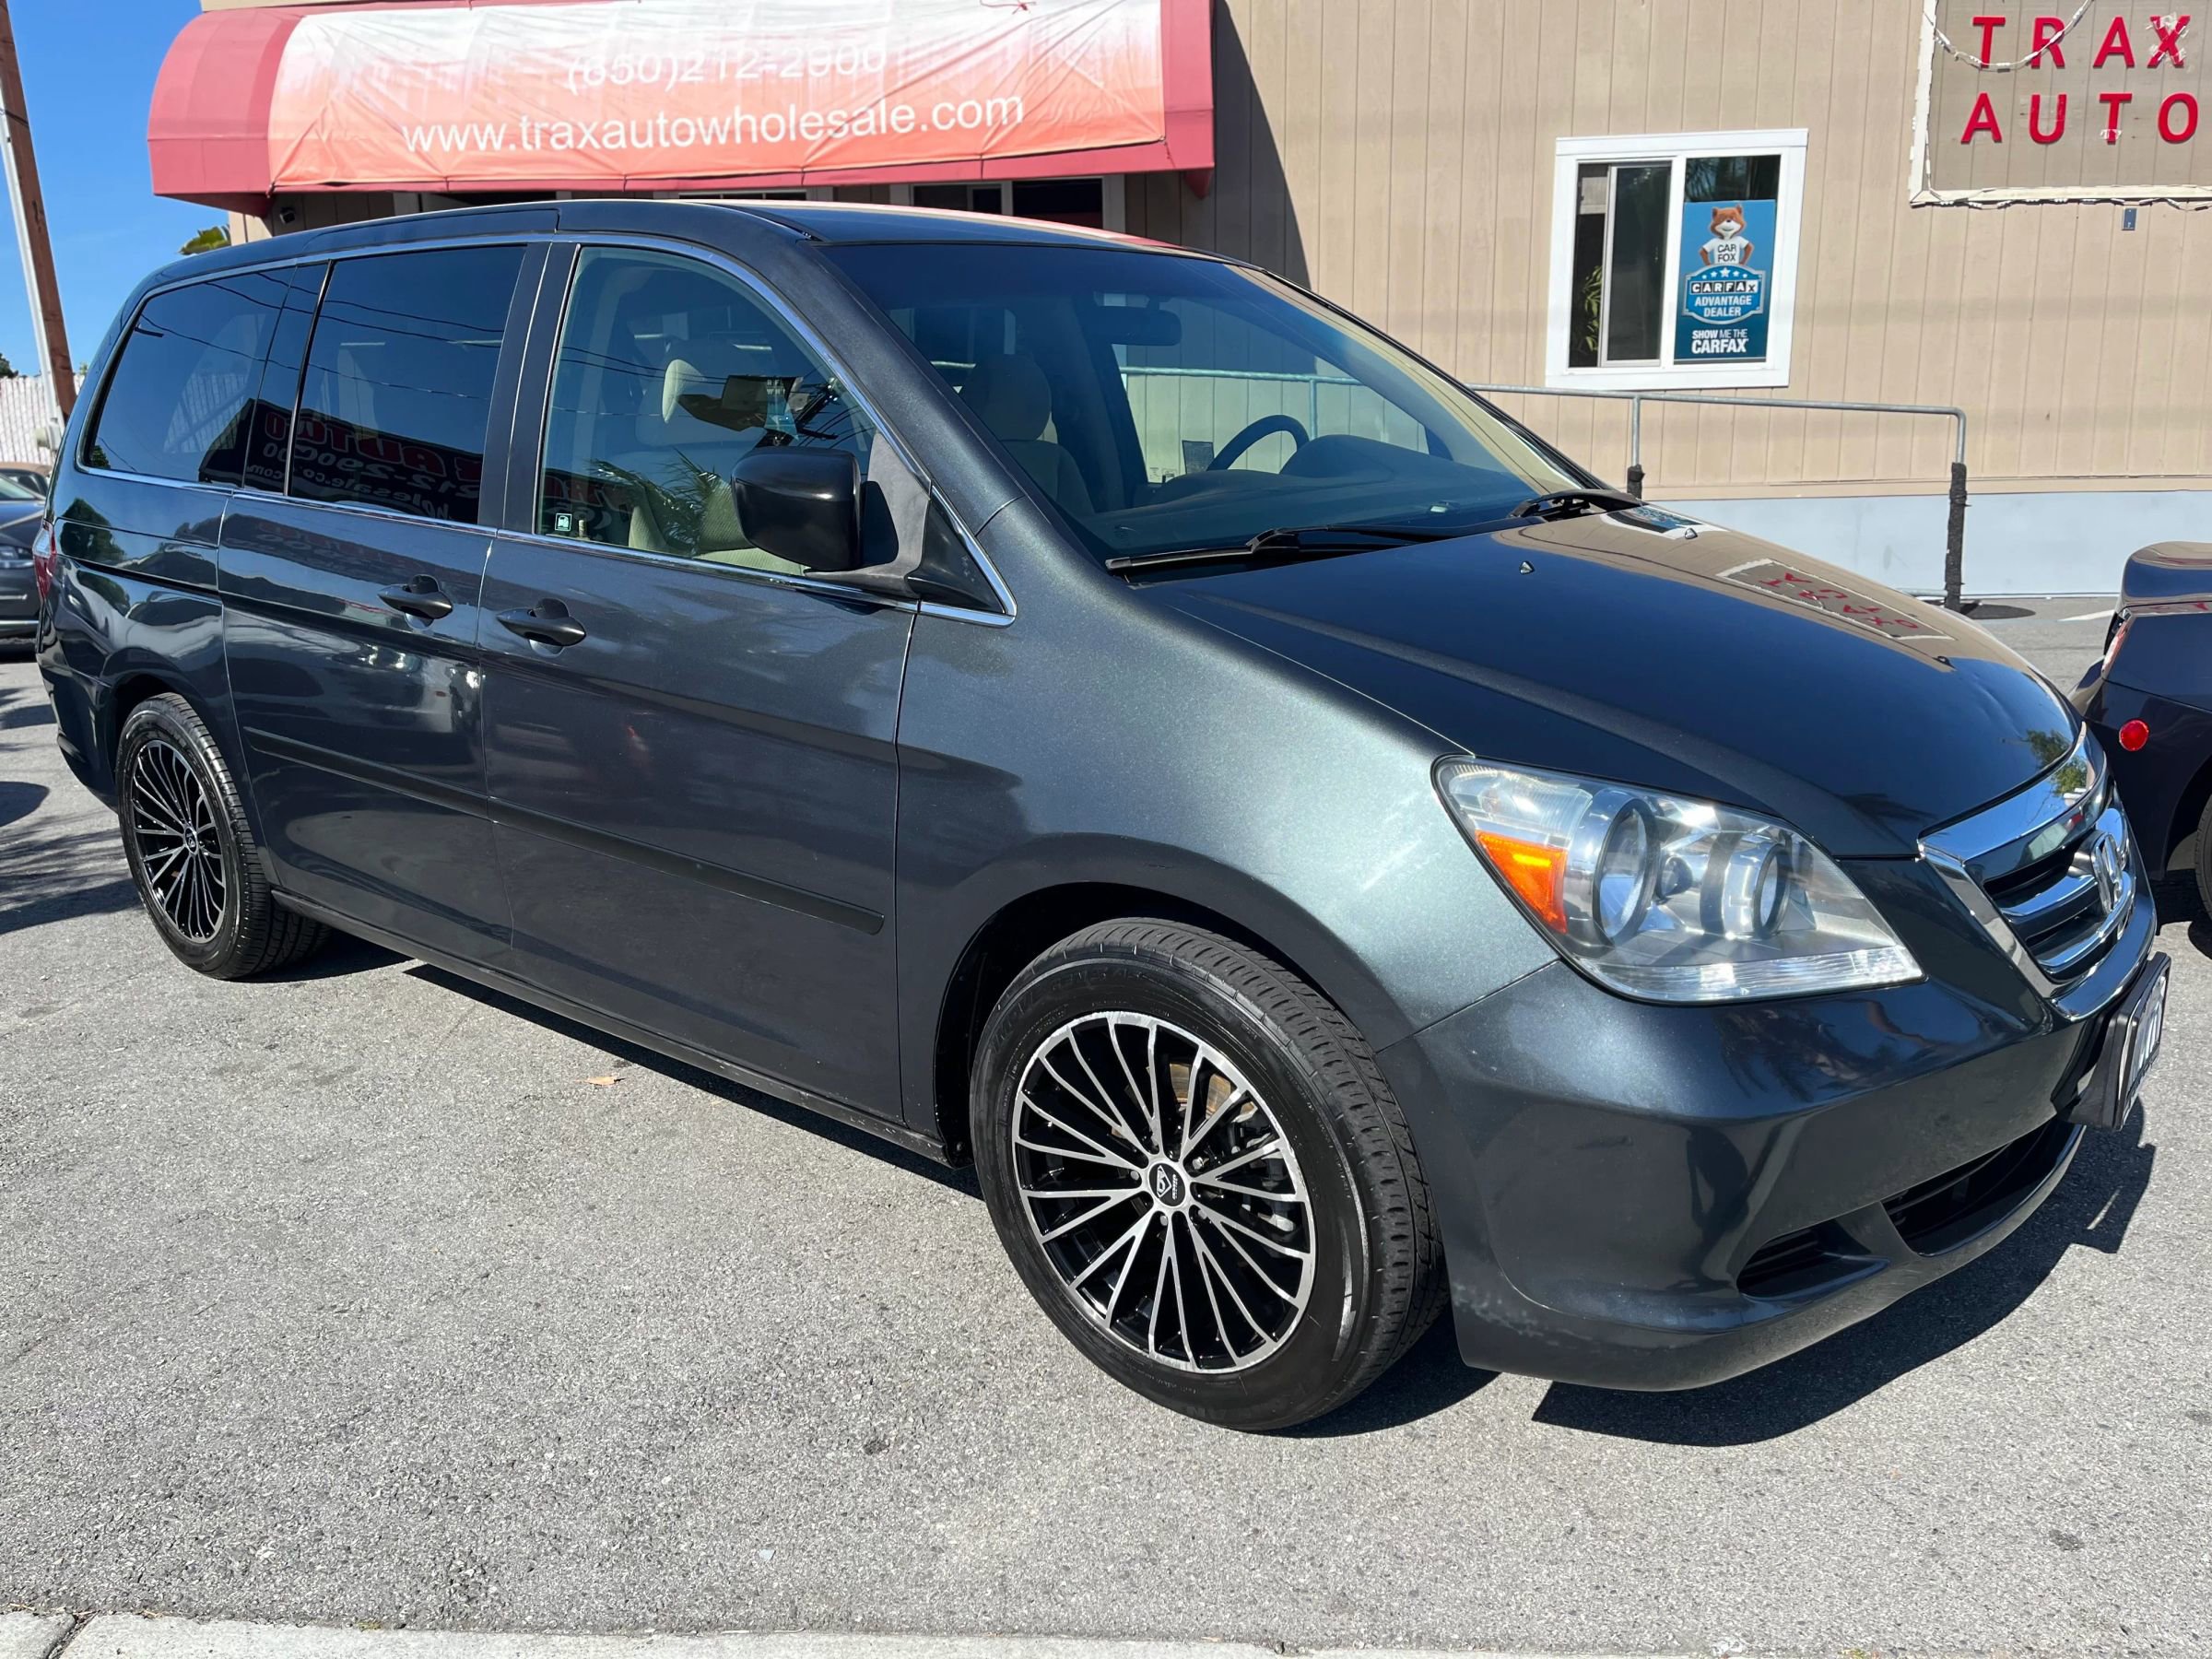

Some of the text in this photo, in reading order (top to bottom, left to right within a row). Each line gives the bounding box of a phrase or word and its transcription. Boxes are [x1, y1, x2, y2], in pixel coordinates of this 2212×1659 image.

[1972, 16, 2191, 69] TRAX
[402, 95, 1024, 152] www.traxautowholesale.com
[1960, 92, 2199, 145] AUTO
[1717, 243, 1736, 253] CAR
[1717, 253, 1736, 263] FOX
[1691, 280, 1758, 293] CARFAX
[1694, 296, 1752, 306] ADVANTAGE
[1703, 307, 1741, 317] DEALER
[1692, 329, 1747, 339] SHOW ME THE
[1691, 338, 1748, 354] CARFAX
